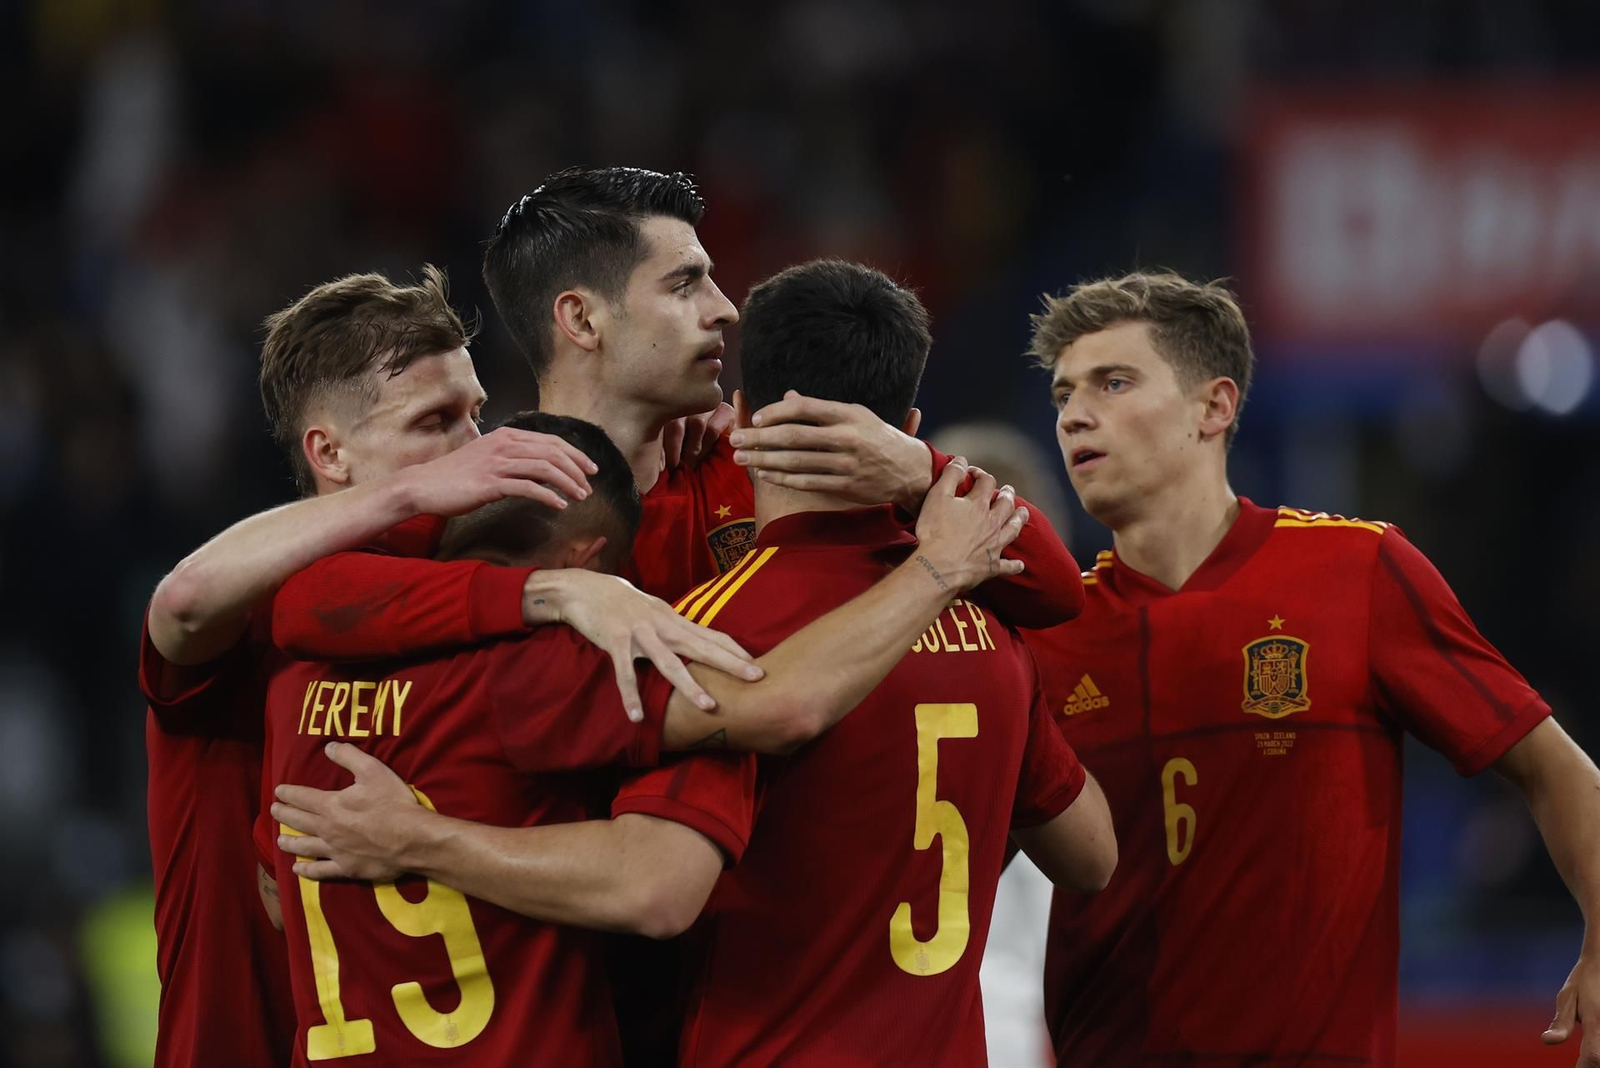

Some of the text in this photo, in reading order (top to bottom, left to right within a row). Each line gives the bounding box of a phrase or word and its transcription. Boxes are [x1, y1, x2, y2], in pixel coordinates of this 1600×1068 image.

[911, 599, 996, 653] LER
[298, 680, 413, 737] YEREMY
[1064, 695, 1110, 716] adidas
[890, 703, 979, 976] 5
[1161, 757, 1198, 866] 6
[279, 784, 495, 1061] 19
